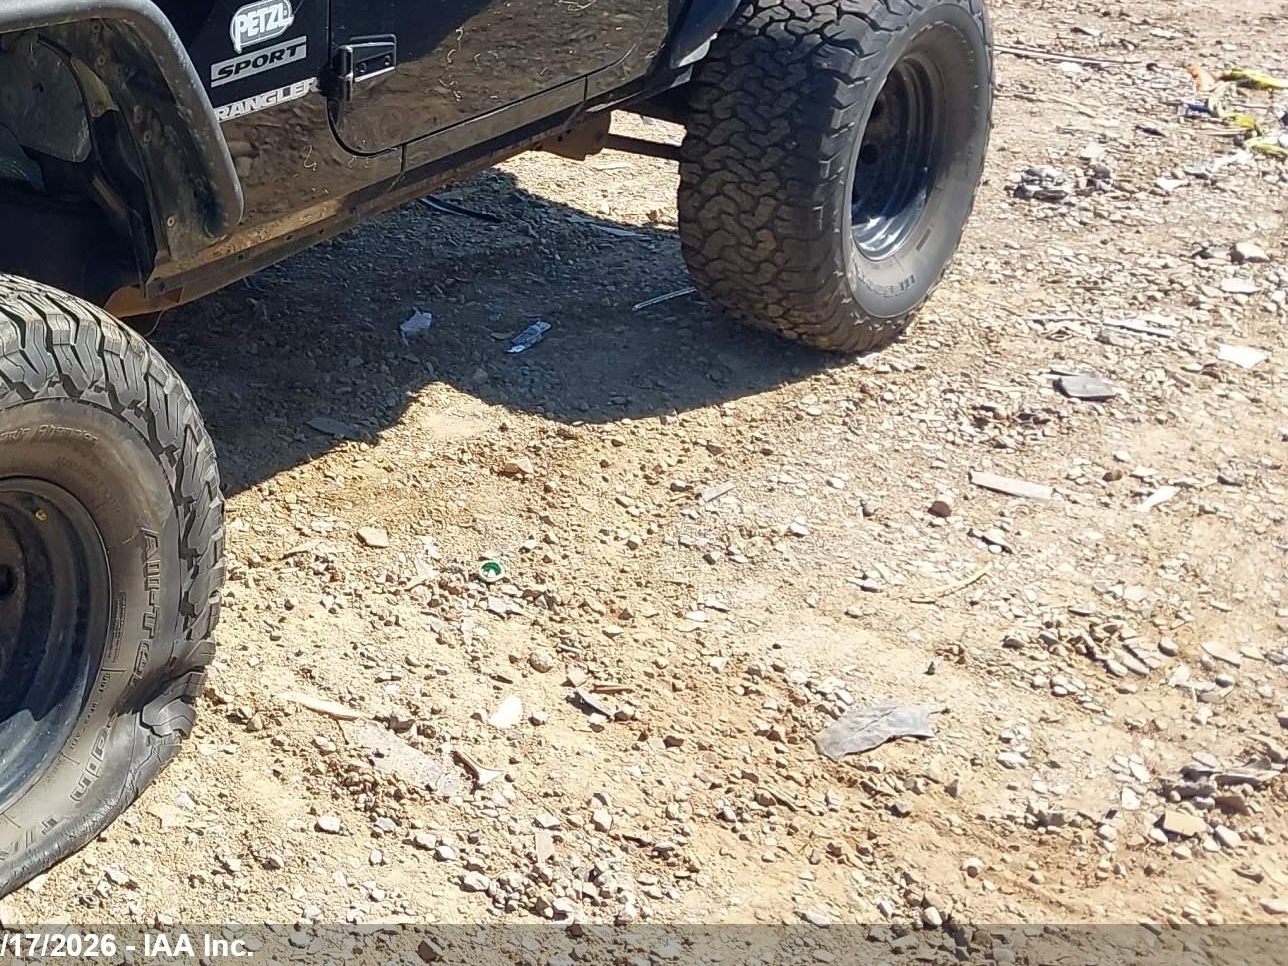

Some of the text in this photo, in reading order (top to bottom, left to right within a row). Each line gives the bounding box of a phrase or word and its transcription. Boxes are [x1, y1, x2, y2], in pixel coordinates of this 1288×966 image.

[233, 1, 294, 54] PETZL
[217, 44, 303, 79] SPORT
[214, 76, 321, 122] RANGLER
